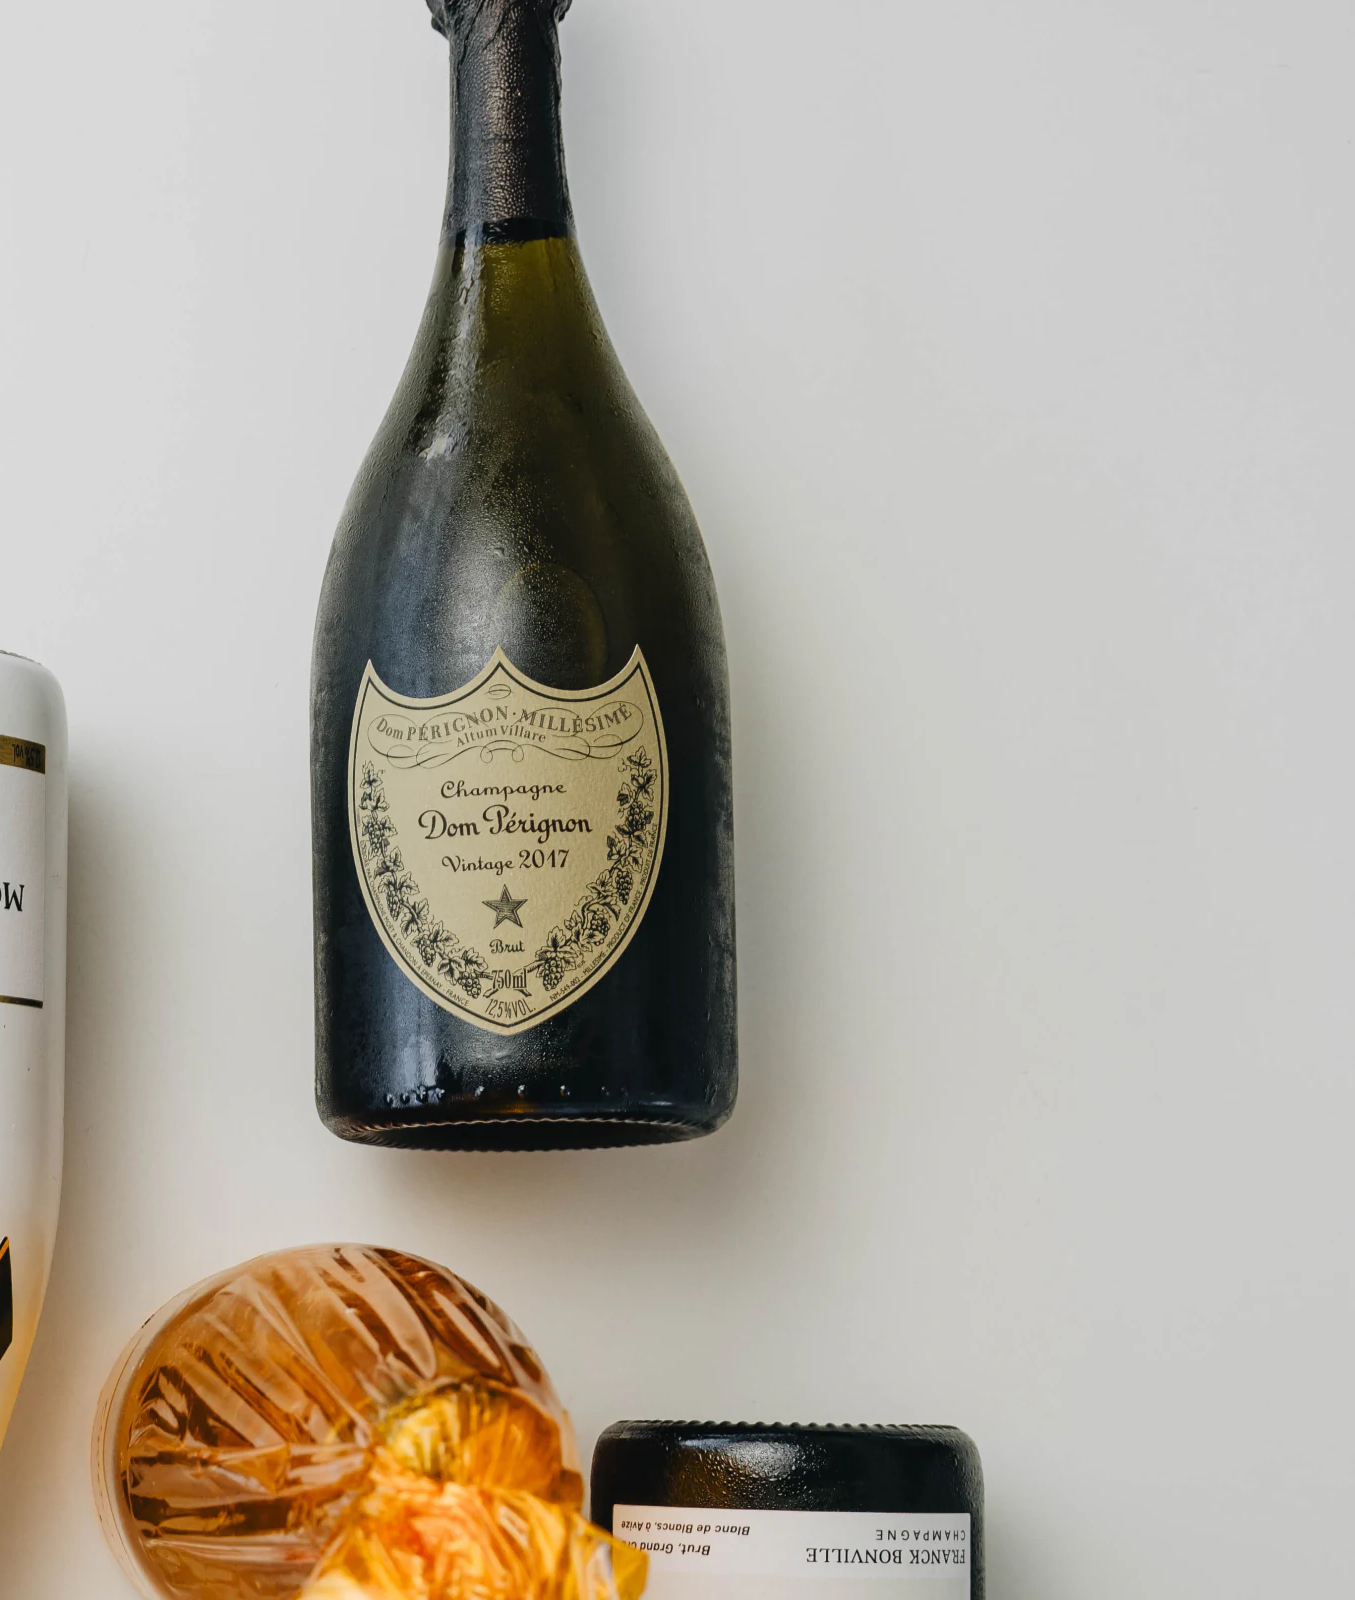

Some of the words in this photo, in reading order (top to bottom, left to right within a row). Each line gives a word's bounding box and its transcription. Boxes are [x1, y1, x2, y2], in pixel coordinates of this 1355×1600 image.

[375, 717, 404, 741] Dom
[406, 705, 509, 741] PÉRIGNON
[519, 702, 633, 734] MILLÉSIMÉ
[456, 728, 498, 748] Altum
[499, 724, 546, 743] Villare
[440, 779, 567, 801] Champagne
[418, 809, 481, 840] Dom
[482, 804, 593, 844] Pérignon
[441, 854, 515, 876] Vintage
[518, 848, 570, 869] 2017
[606, 922, 626, 950] PRODUCT
[628, 891, 643, 914] FRANCE
[639, 860, 652, 886] PRODUIT
[649, 823, 658, 851] FRANCE
[489, 938, 525, 954] Brut
[396, 937, 418, 968] CHANDON
[445, 988, 469, 1007] FRANCE
[621, 1520, 644, 1531] Avize
[654, 1521, 693, 1534] Blancs,
[696, 1524, 711, 1534] de
[714, 1524, 751, 1536] Blanc
[875, 1529, 966, 1541] CHAMPAGNE
[639, 1541, 674, 1554] Grand
[678, 1542, 711, 1556] Brut,
[806, 1547, 903, 1564] BONVILLE
[909, 1549, 966, 1565] FRANCK
